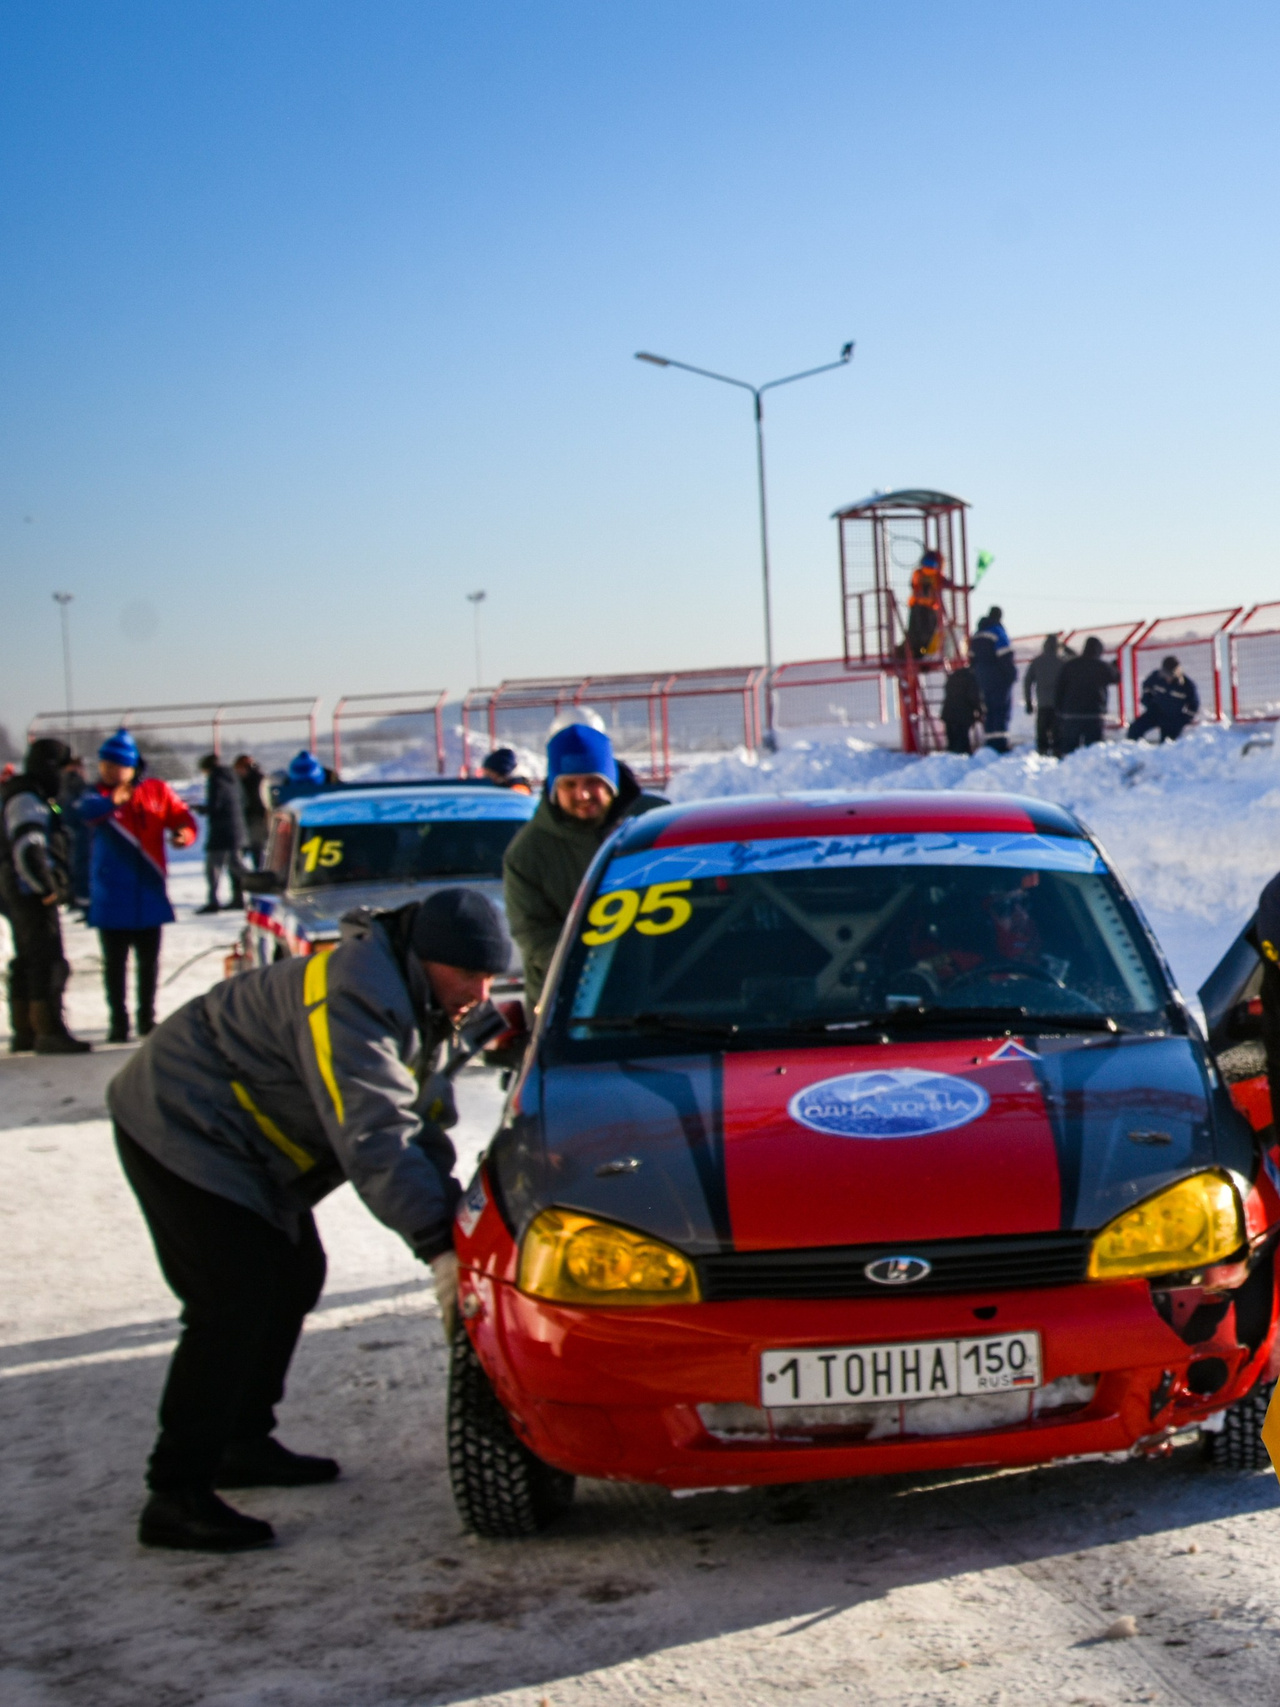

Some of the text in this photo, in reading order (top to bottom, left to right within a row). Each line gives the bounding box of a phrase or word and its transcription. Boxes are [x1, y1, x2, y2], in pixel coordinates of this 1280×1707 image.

[301, 836, 343, 873] 15
[581, 879, 694, 947] 95
[778, 1340, 1026, 1400] 1 ТОННА 150
[978, 1374, 1010, 1389] RUS
